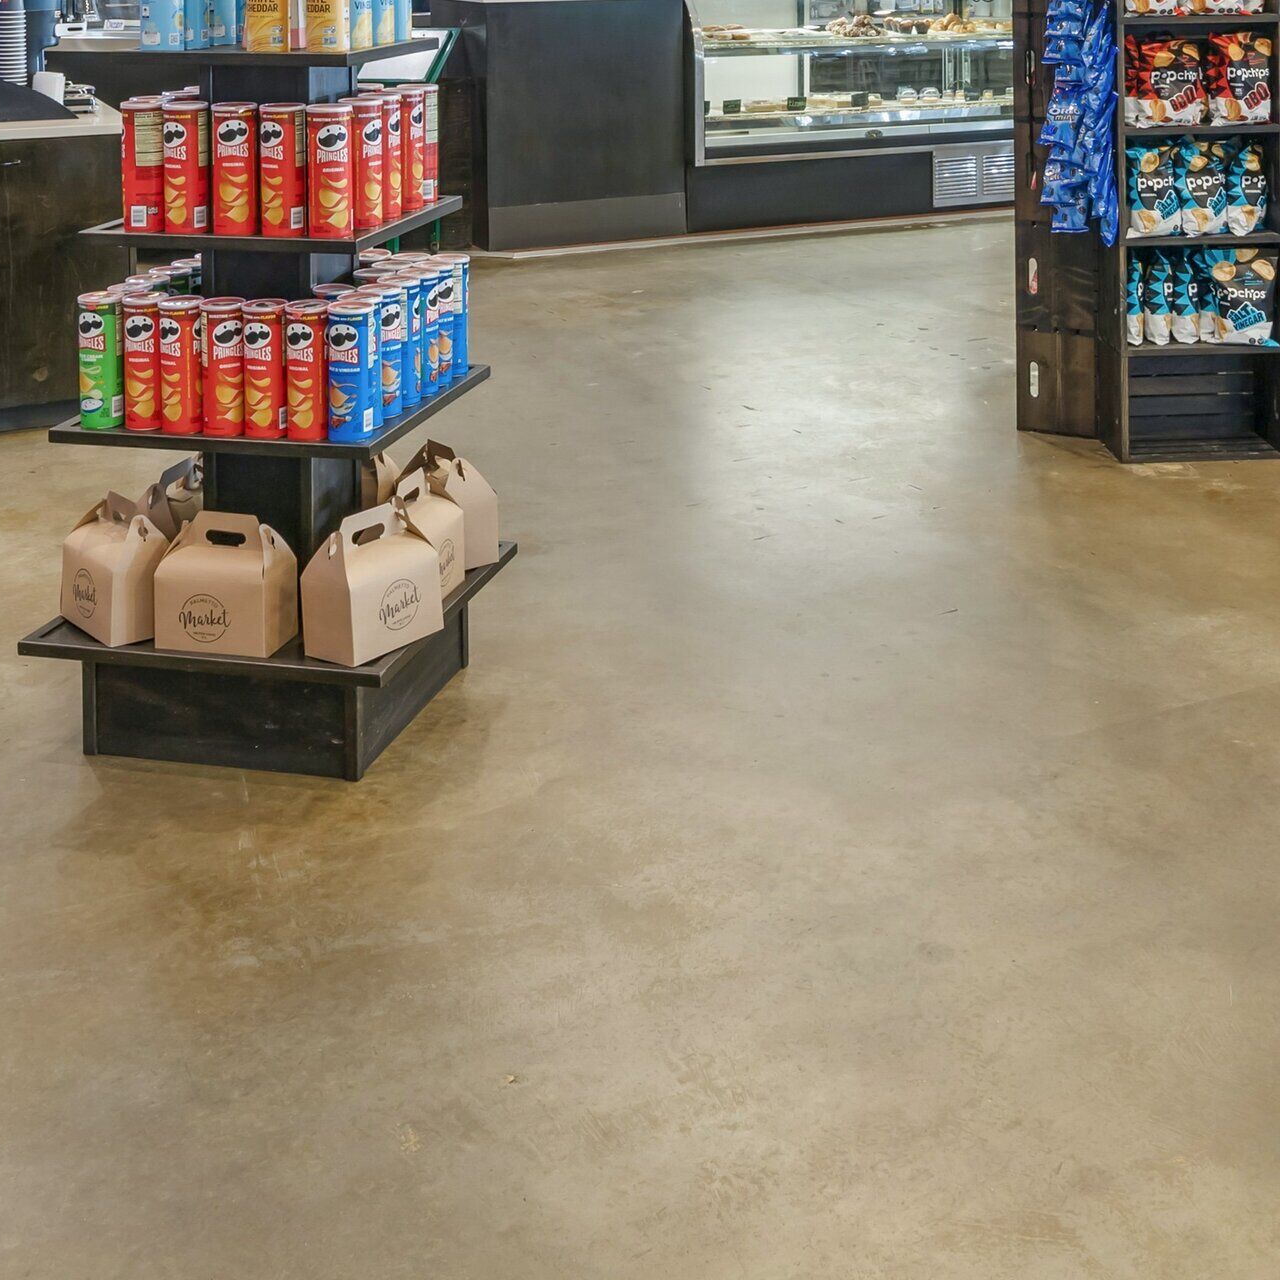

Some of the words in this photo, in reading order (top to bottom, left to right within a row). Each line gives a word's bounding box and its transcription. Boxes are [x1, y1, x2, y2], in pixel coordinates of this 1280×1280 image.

[1150, 70, 1198, 84] popchip
[1227, 67, 1270, 81] popchips
[218, 144, 249, 158] PRINGLES
[317, 148, 348, 164] PRINGLES
[1231, 303, 1250, 324] SALT
[1233, 312, 1265, 331] VINEGAR
[213, 345, 243, 361] PRINGLES
[190, 599, 218, 608] PALMETTO
[379, 585, 421, 625] Market
[179, 609, 231, 630] Market
